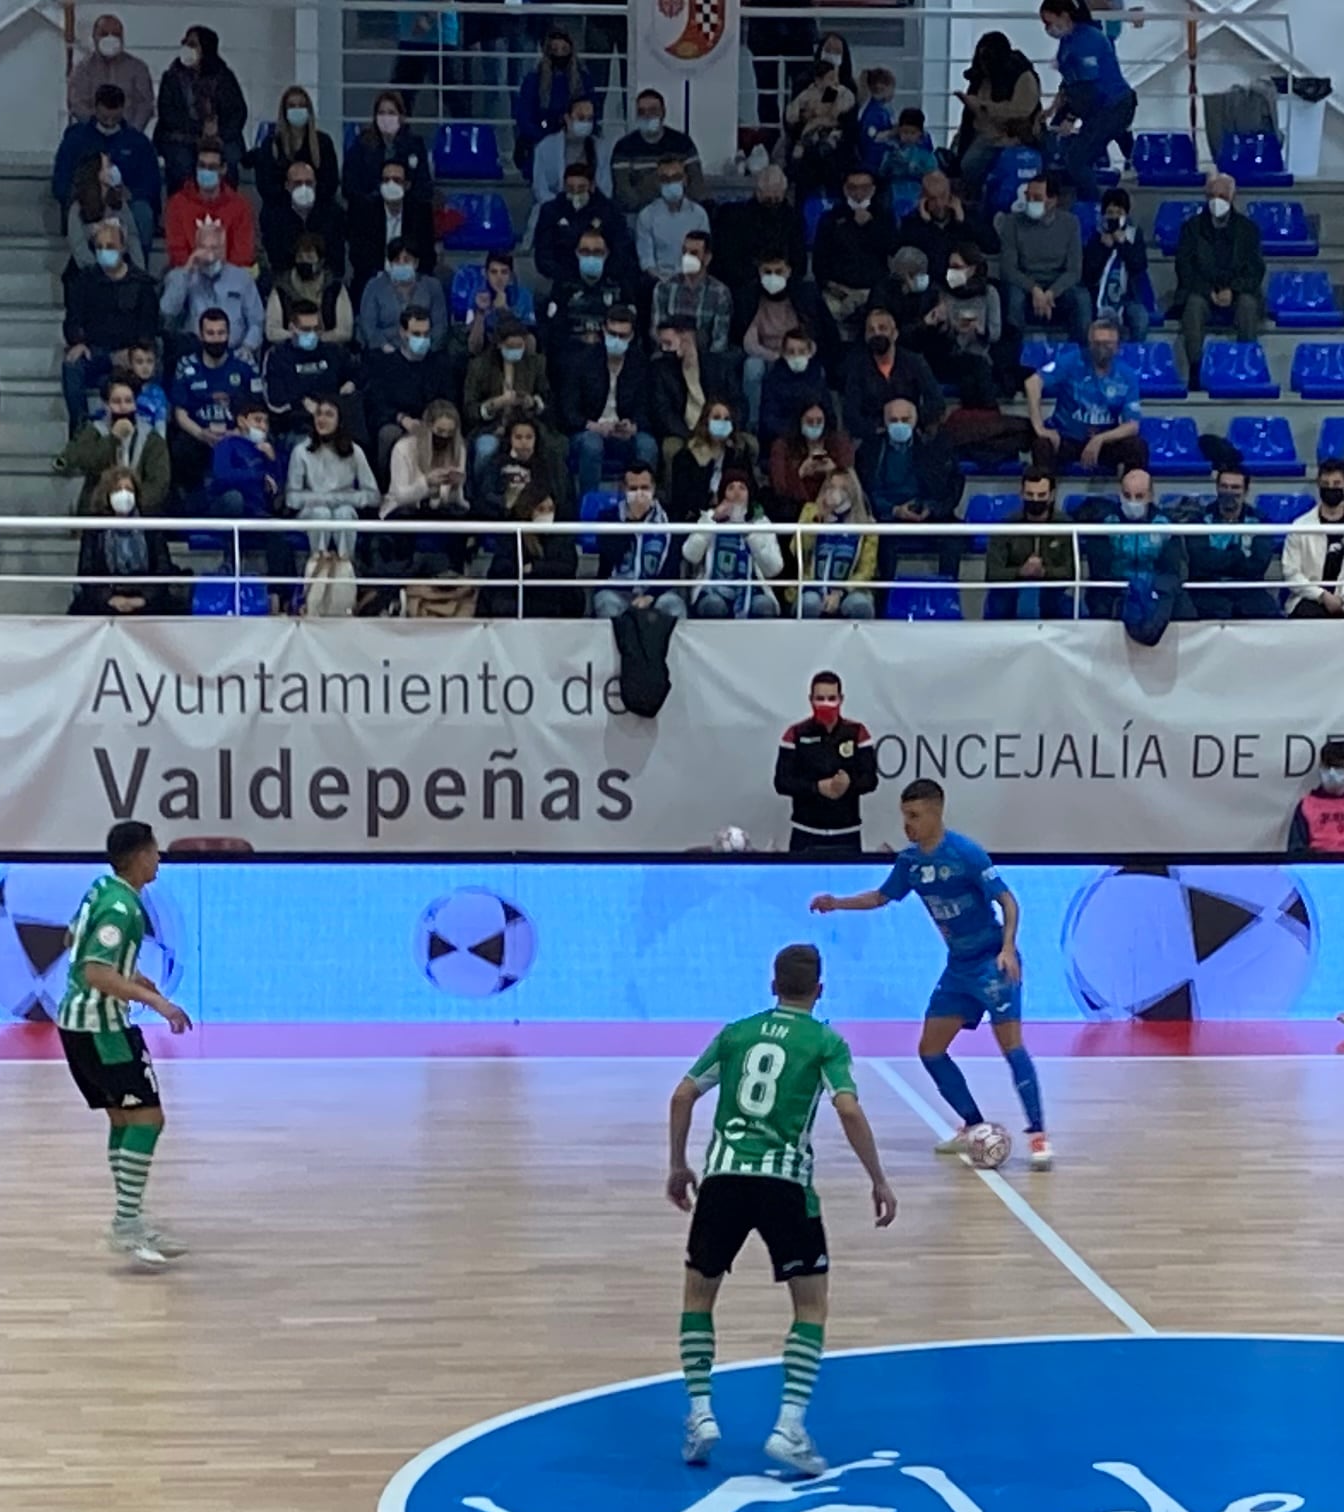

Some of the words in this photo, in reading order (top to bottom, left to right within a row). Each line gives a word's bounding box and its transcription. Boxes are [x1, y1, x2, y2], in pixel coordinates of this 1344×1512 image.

[92, 659, 536, 727] Ayuntamiento
[874, 719, 1168, 780] ONCEJALÍA
[1192, 734, 1261, 779] DE
[93, 748, 634, 838] Valdepeñas
[760, 1021, 790, 1039] LIN
[736, 1041, 787, 1118] 8
